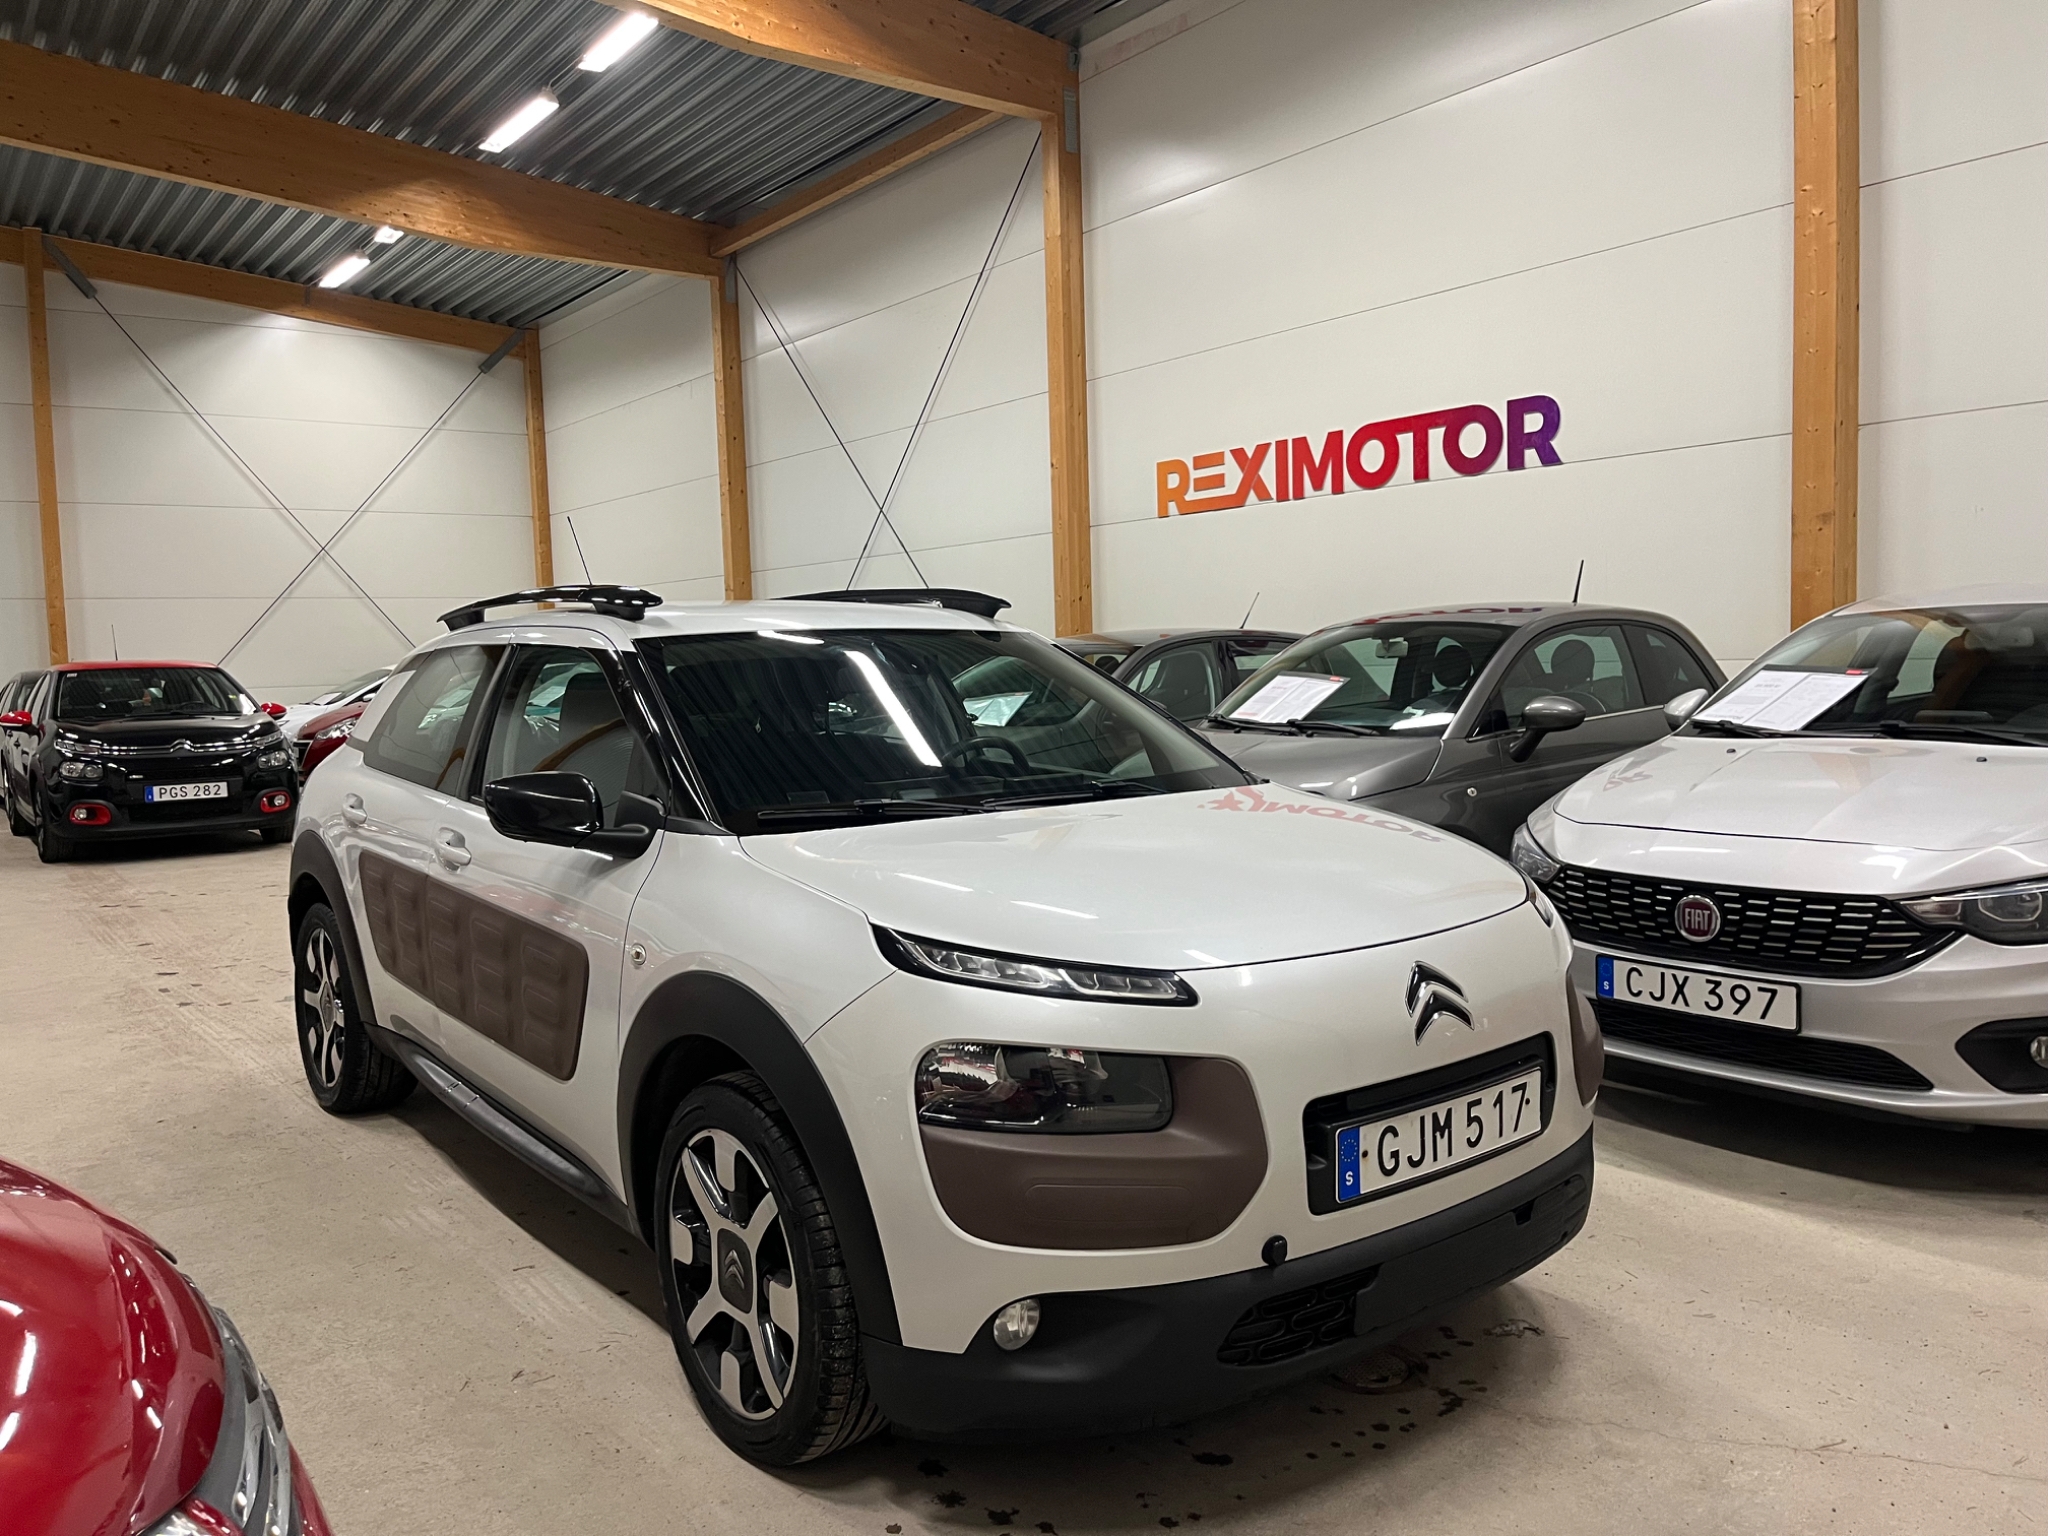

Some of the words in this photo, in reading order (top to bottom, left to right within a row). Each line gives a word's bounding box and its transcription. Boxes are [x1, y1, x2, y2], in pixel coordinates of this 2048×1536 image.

[1156, 394, 1563, 518] REXIMOTOR
[158, 786, 188, 799] PGS
[193, 784, 222, 797] 282
[1684, 907, 1711, 931] FIAT
[1626, 966, 1690, 1008] CJX
[1704, 978, 1778, 1020] 397
[1377, 1106, 1453, 1177] GJM
[1466, 1081, 1528, 1148] 517
[1345, 1170, 1354, 1187] S
